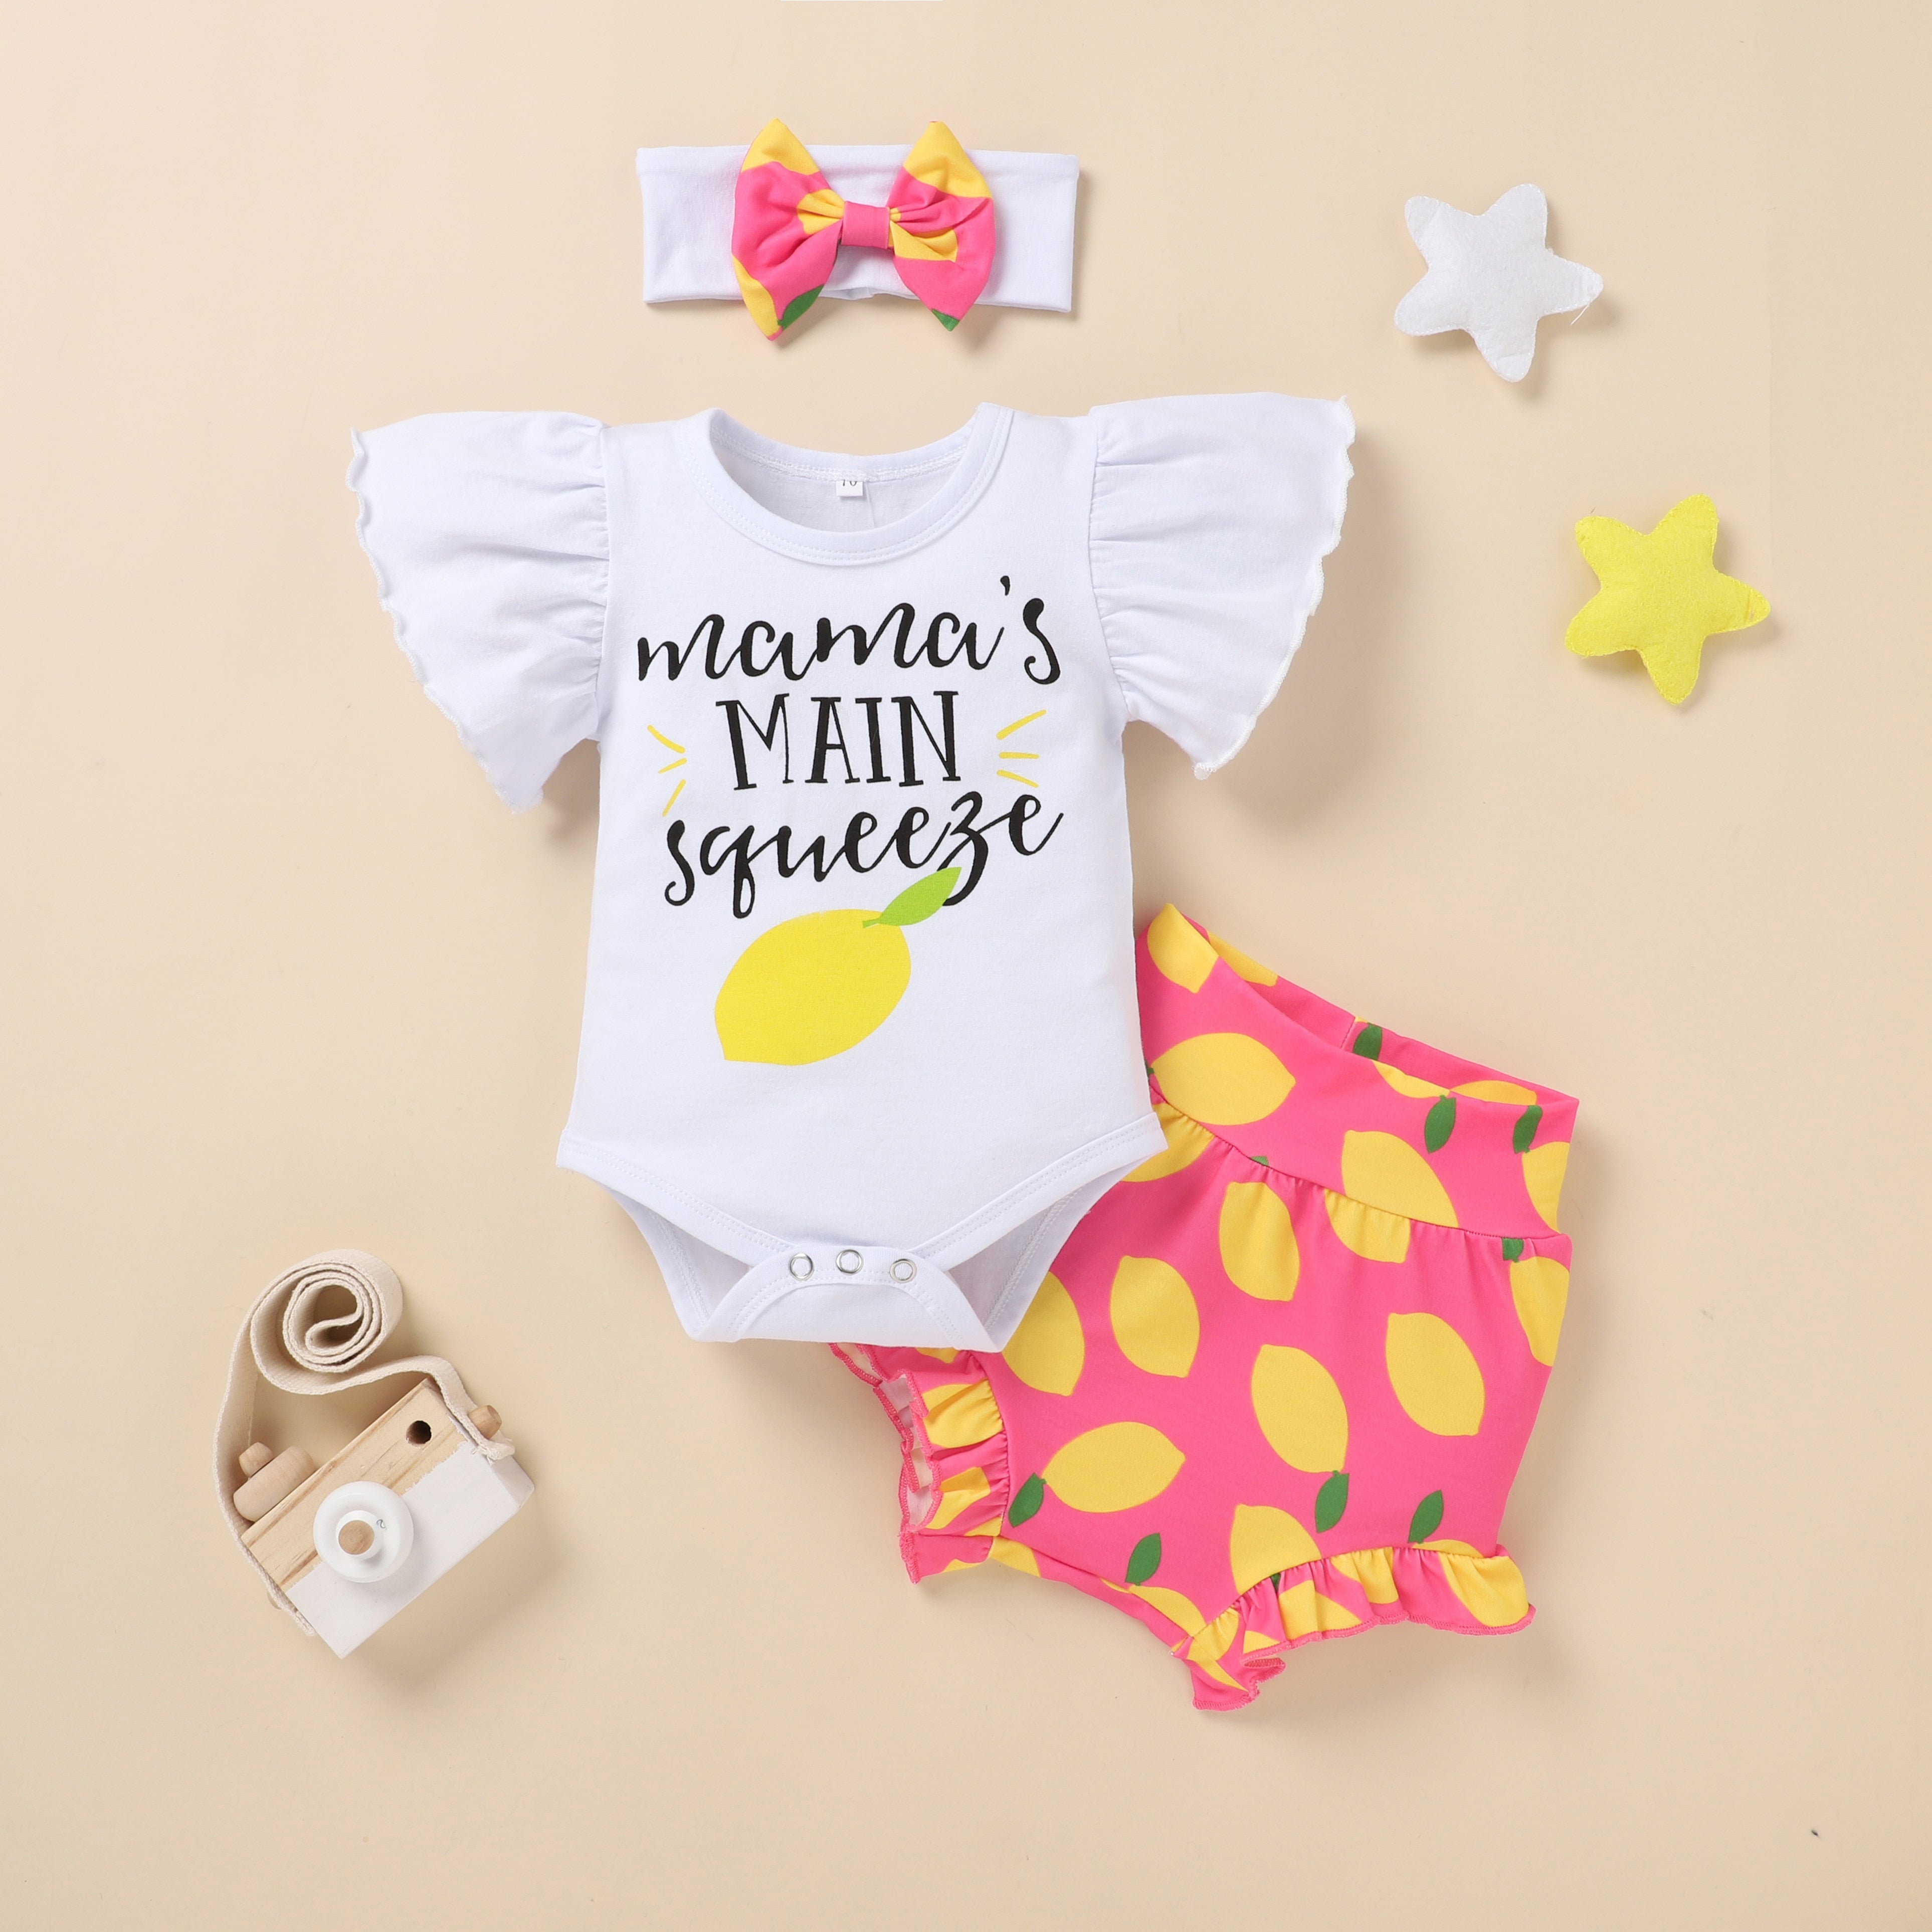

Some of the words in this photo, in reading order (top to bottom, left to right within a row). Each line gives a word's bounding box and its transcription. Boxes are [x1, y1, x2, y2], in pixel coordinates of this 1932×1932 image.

[637, 575, 1061, 685] mama's
[715, 691, 961, 791] MAIN
[664, 791, 1064, 919] squeeze
